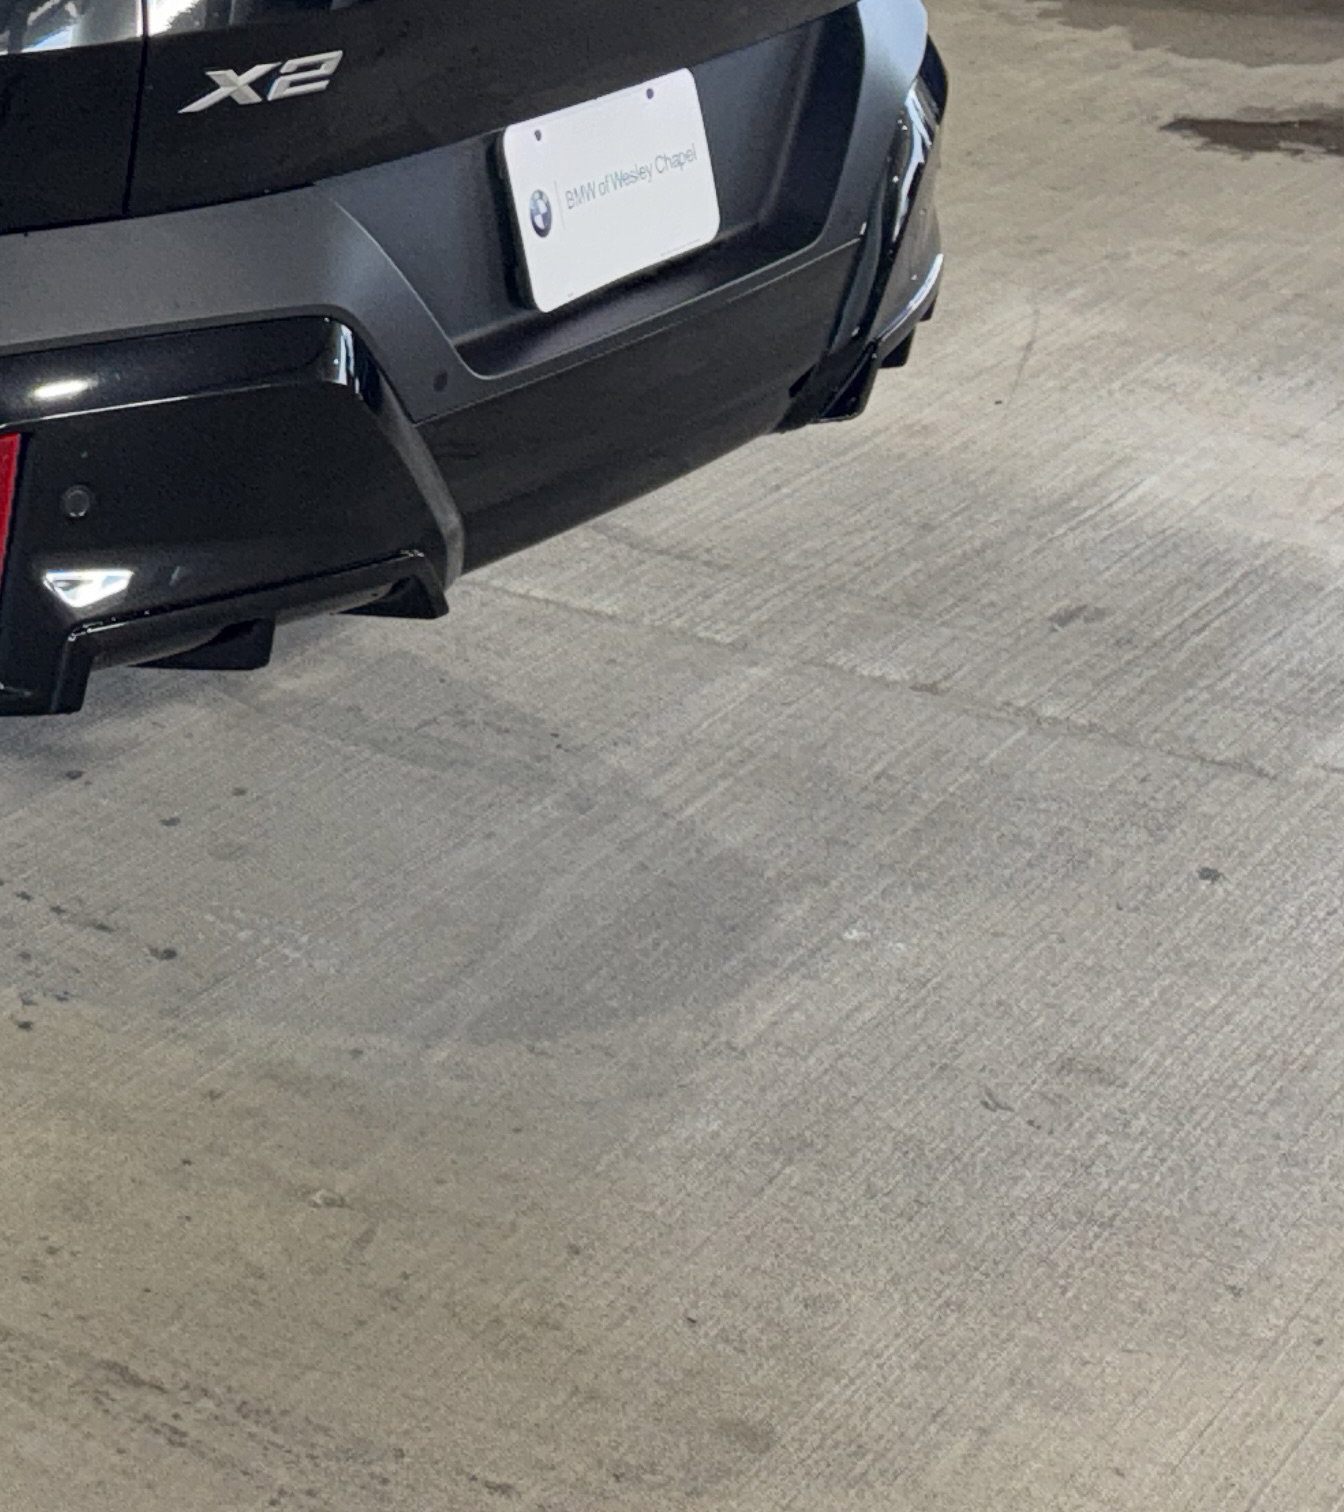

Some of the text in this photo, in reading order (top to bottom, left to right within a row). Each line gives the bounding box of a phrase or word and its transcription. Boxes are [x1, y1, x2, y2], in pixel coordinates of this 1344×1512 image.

[176, 49, 344, 115] X2
[565, 142, 698, 210] BMW of Wesley Chapel
